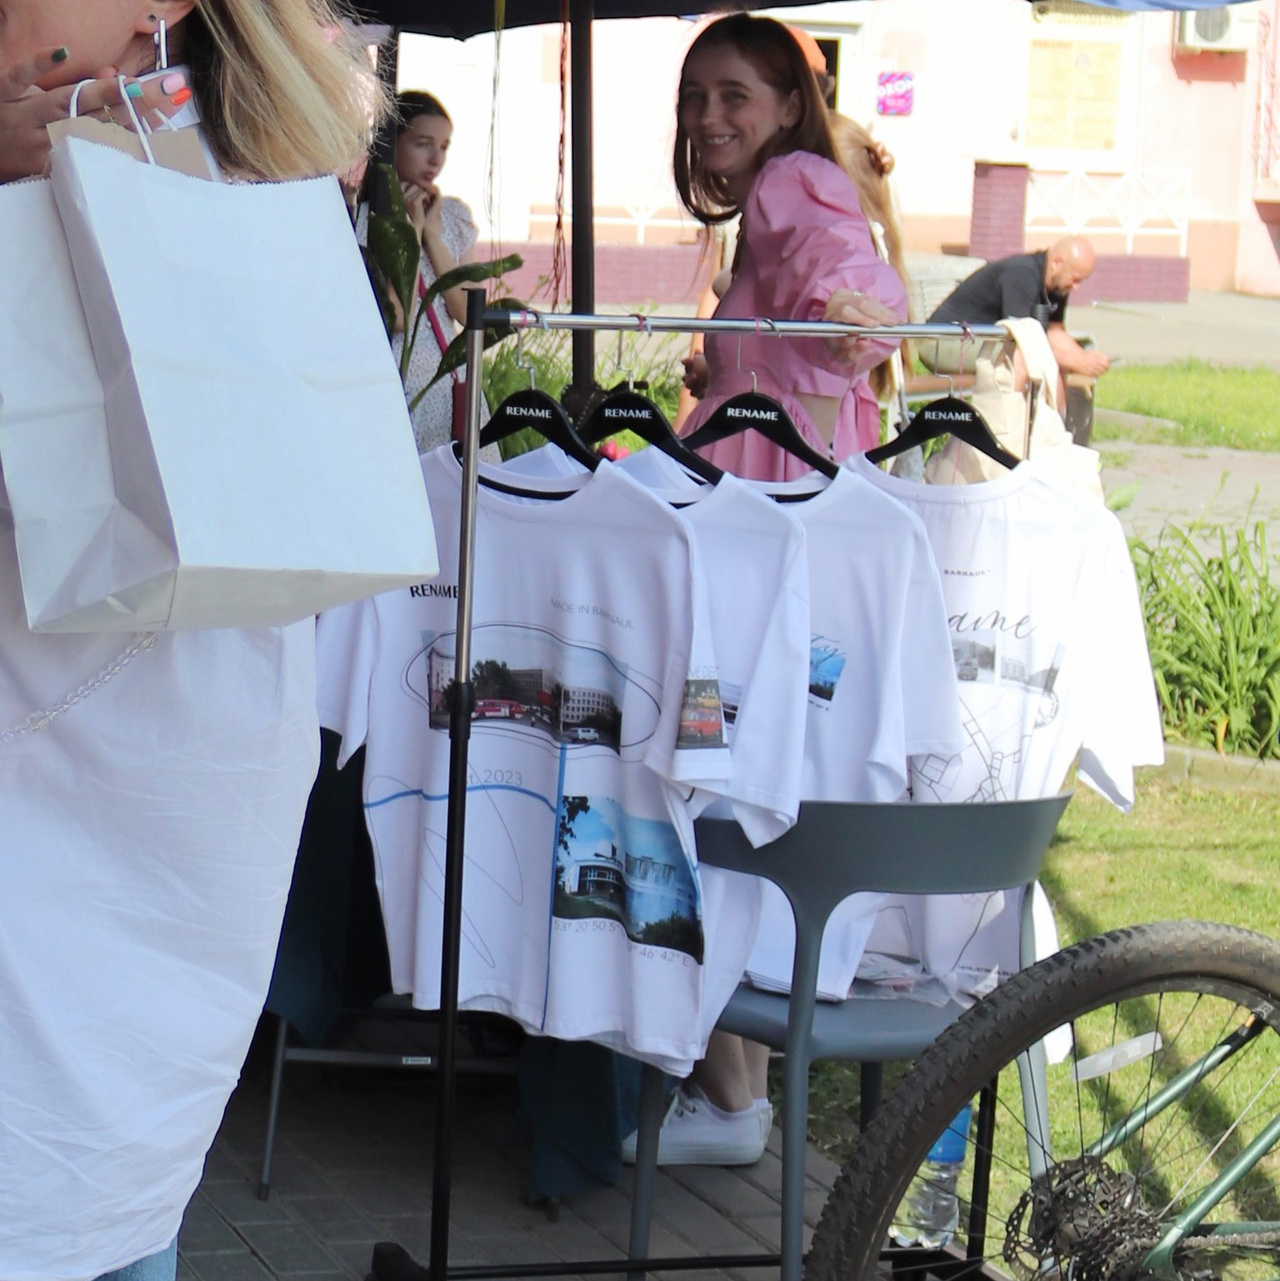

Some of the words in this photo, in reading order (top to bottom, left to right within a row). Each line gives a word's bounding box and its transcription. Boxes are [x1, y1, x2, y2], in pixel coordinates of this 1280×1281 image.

[506, 405, 553, 419] RENAME
[604, 407, 653, 419] RENAME
[726, 406, 779, 421] RENAME
[924, 409, 973, 422] RENAME
[578, 605, 590, 614] IN
[484, 768, 523, 786] 2023
